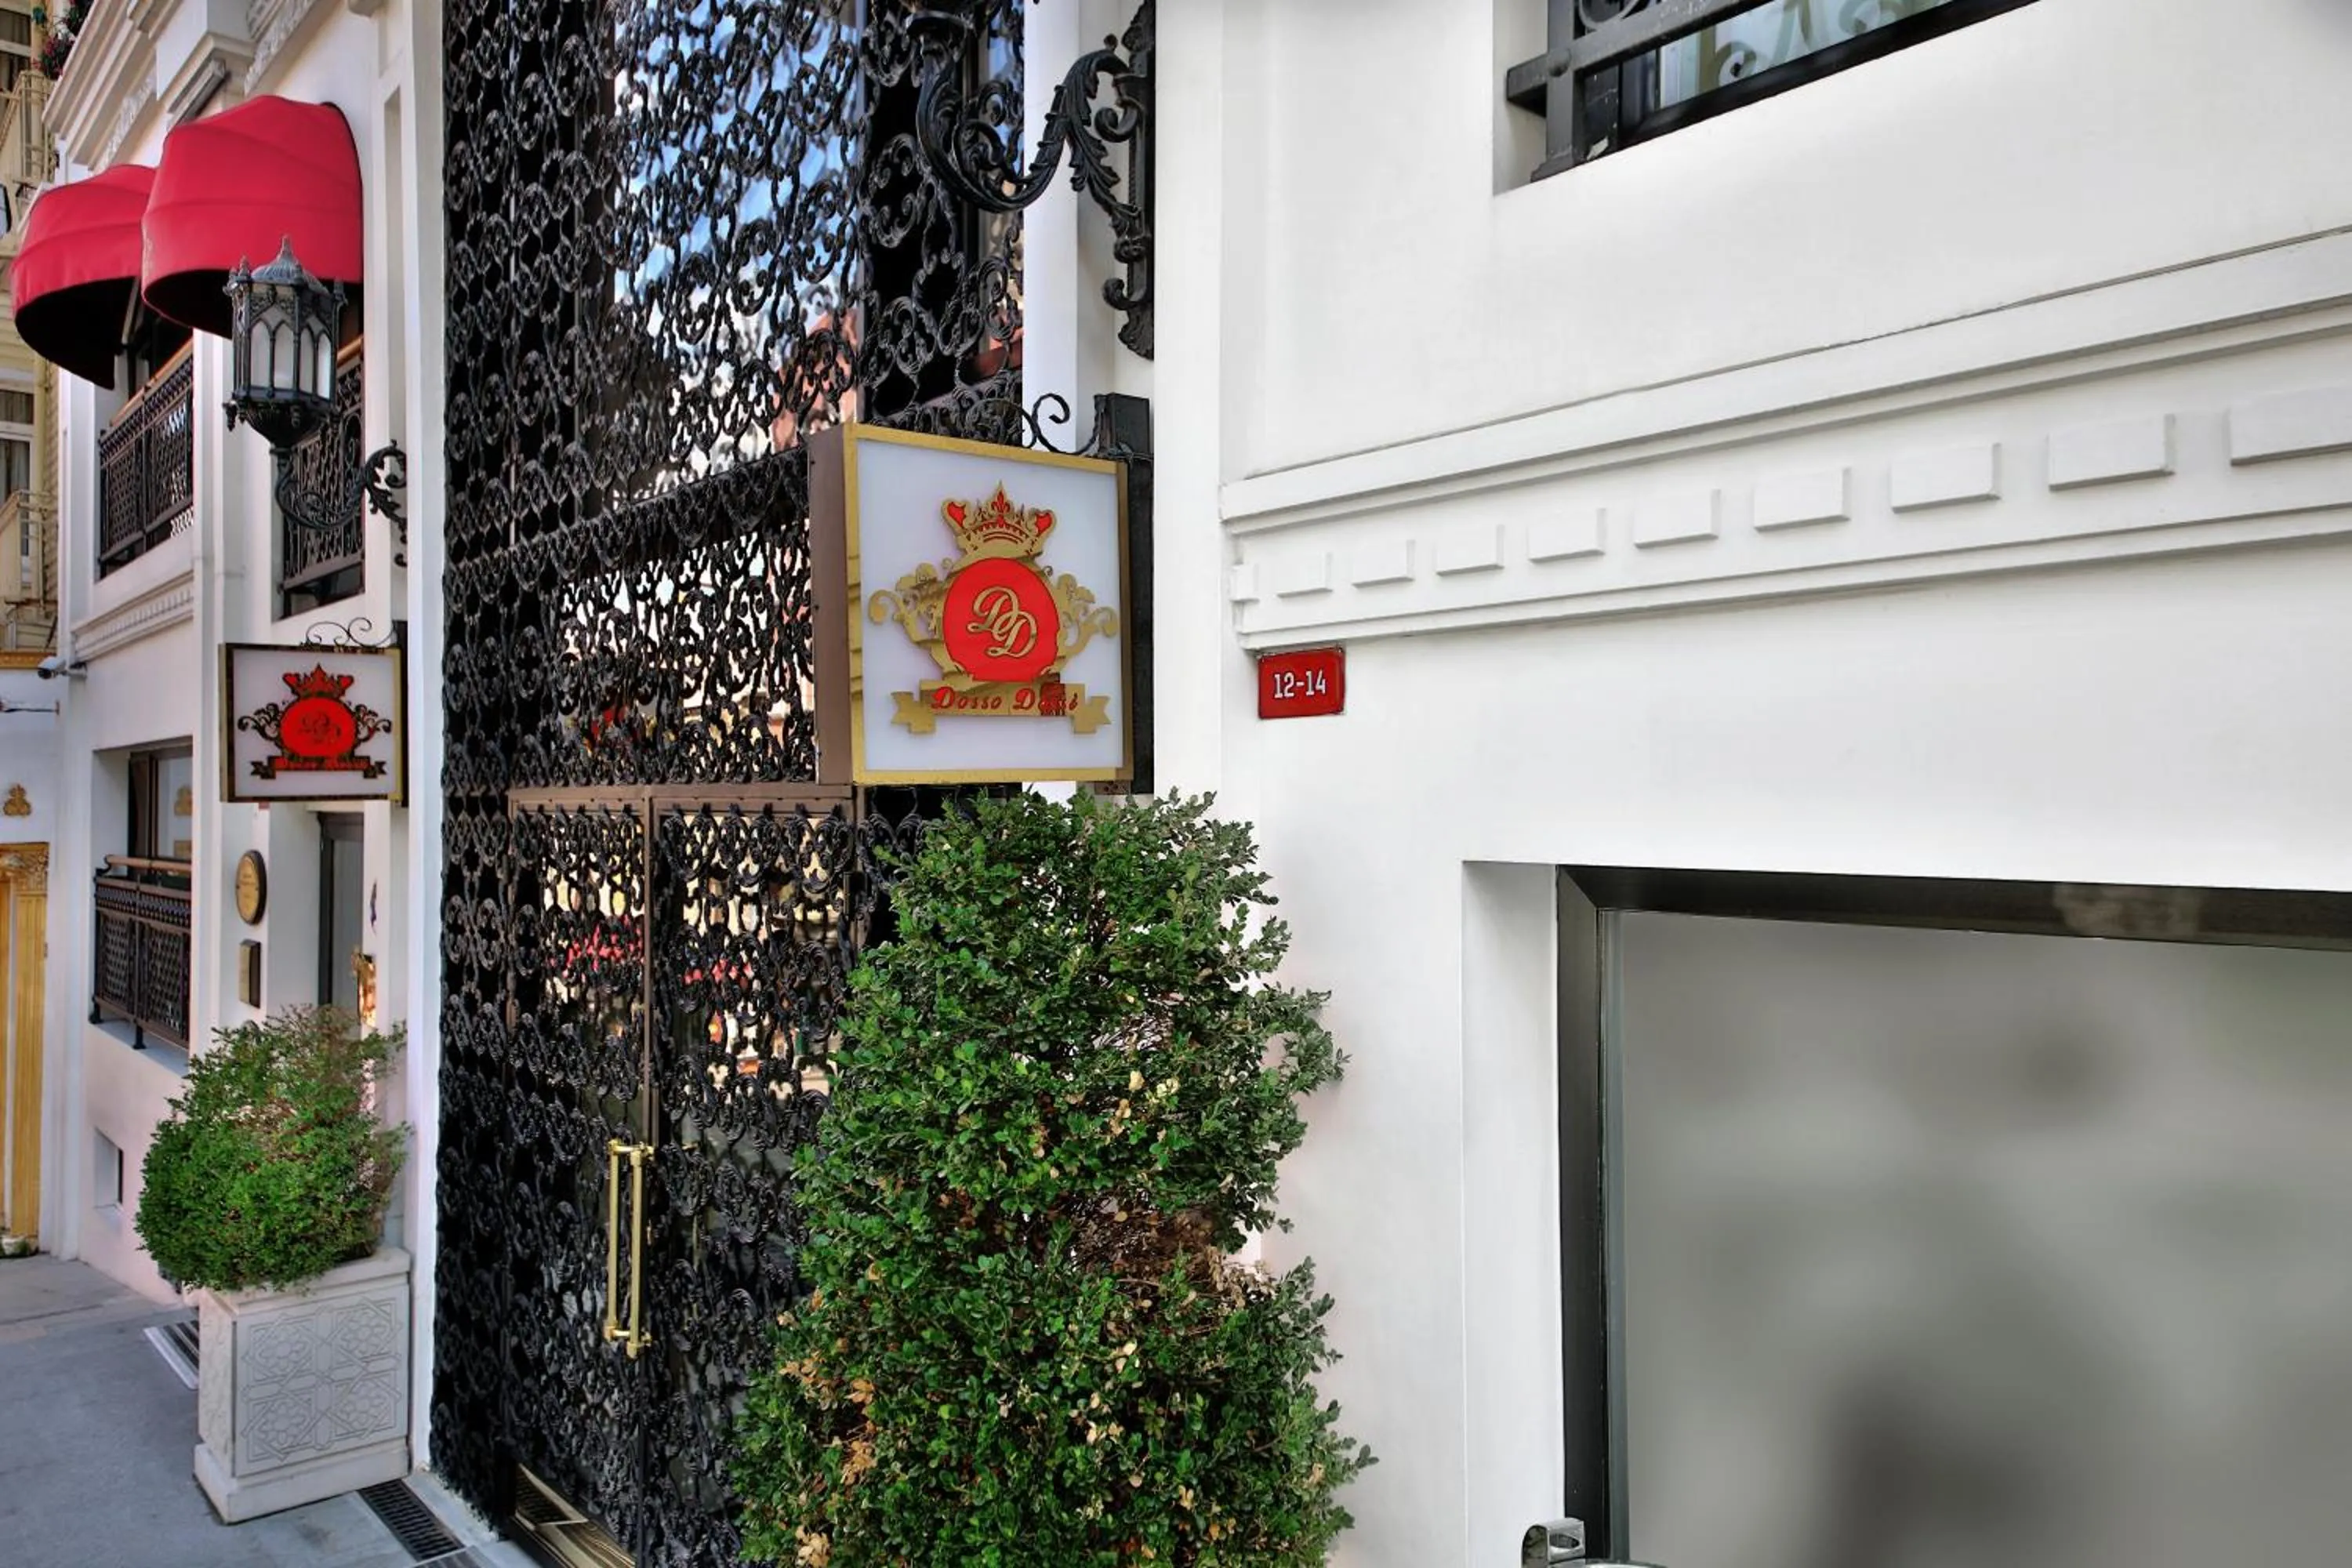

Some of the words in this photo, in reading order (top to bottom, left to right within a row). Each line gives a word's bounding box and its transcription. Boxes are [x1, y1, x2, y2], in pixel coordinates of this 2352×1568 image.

[1274, 669, 1326, 699] 12-14
[931, 686, 1002, 710] Dosso
[1012, 688, 1078, 713] Doi
